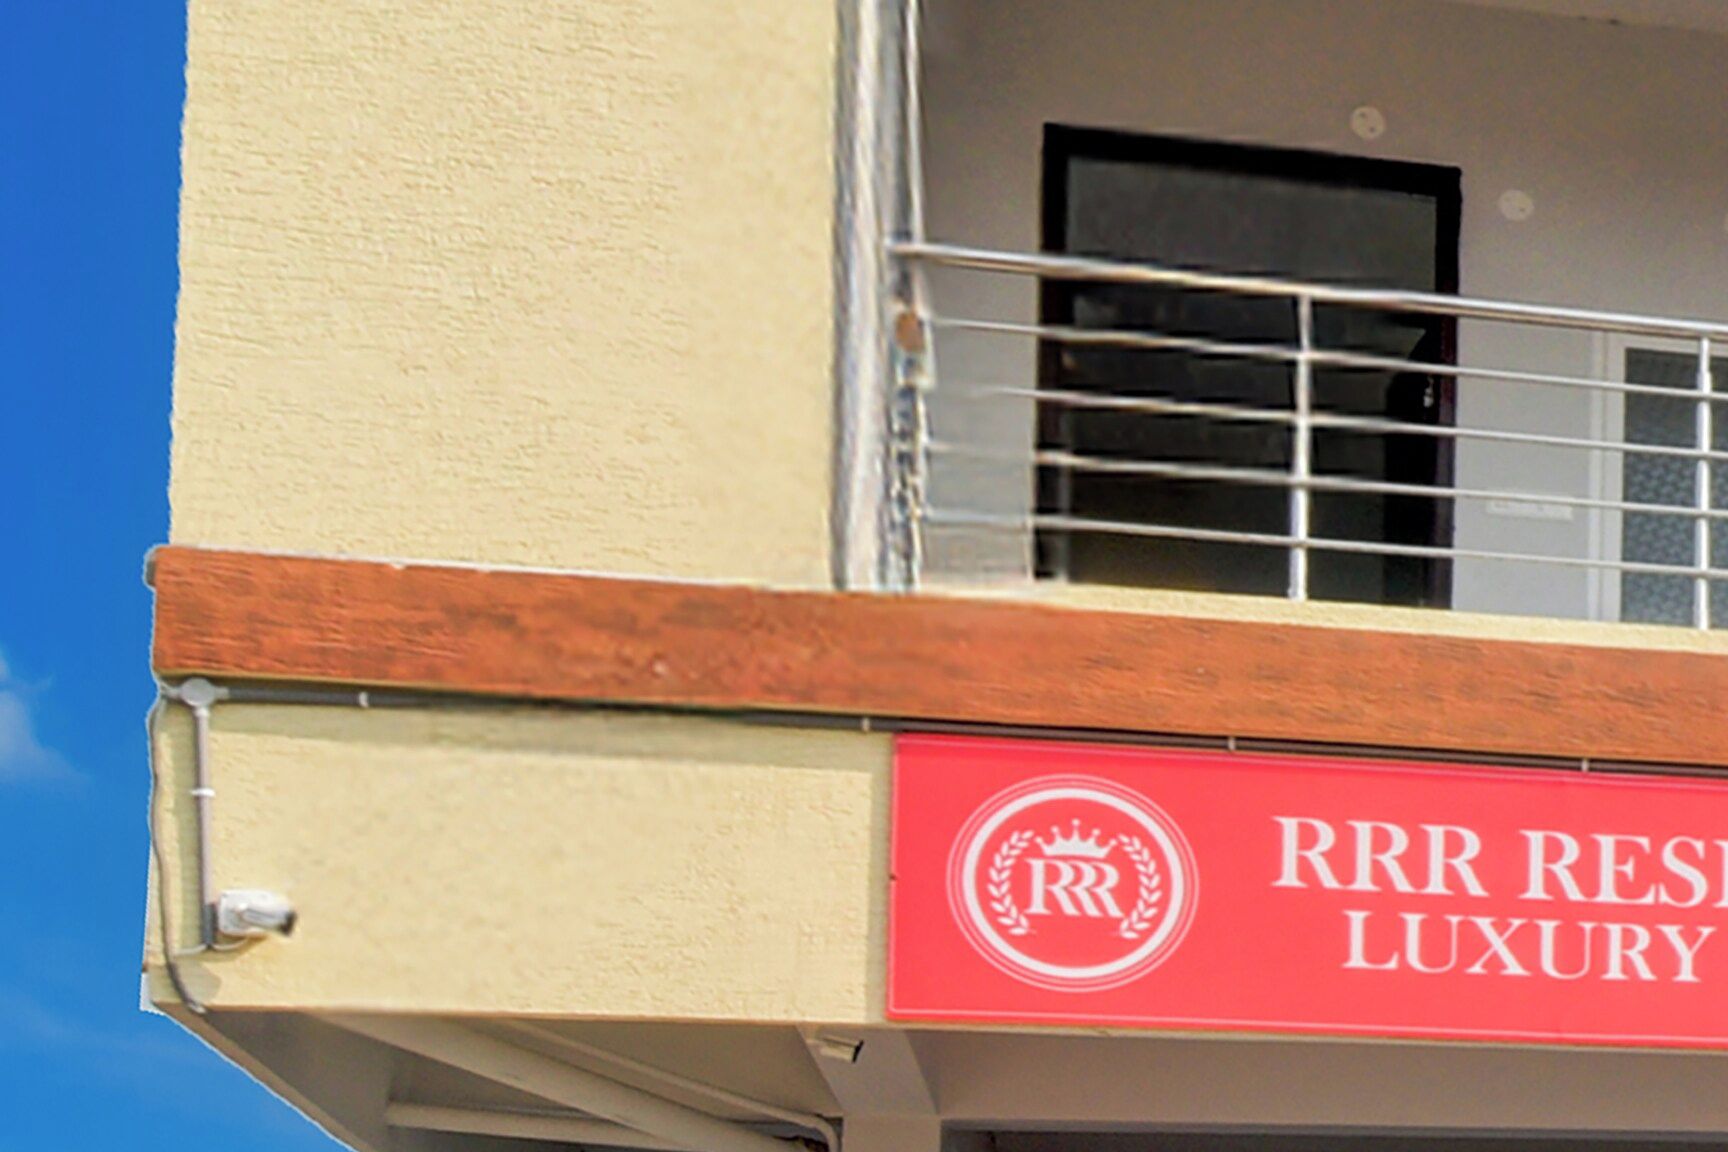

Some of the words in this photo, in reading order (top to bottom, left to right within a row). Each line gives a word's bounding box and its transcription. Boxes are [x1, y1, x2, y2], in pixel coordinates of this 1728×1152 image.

[1023, 857, 1125, 919] RRR
[1272, 815, 1490, 898] RRR
[1342, 909, 1717, 984] LUXURY
